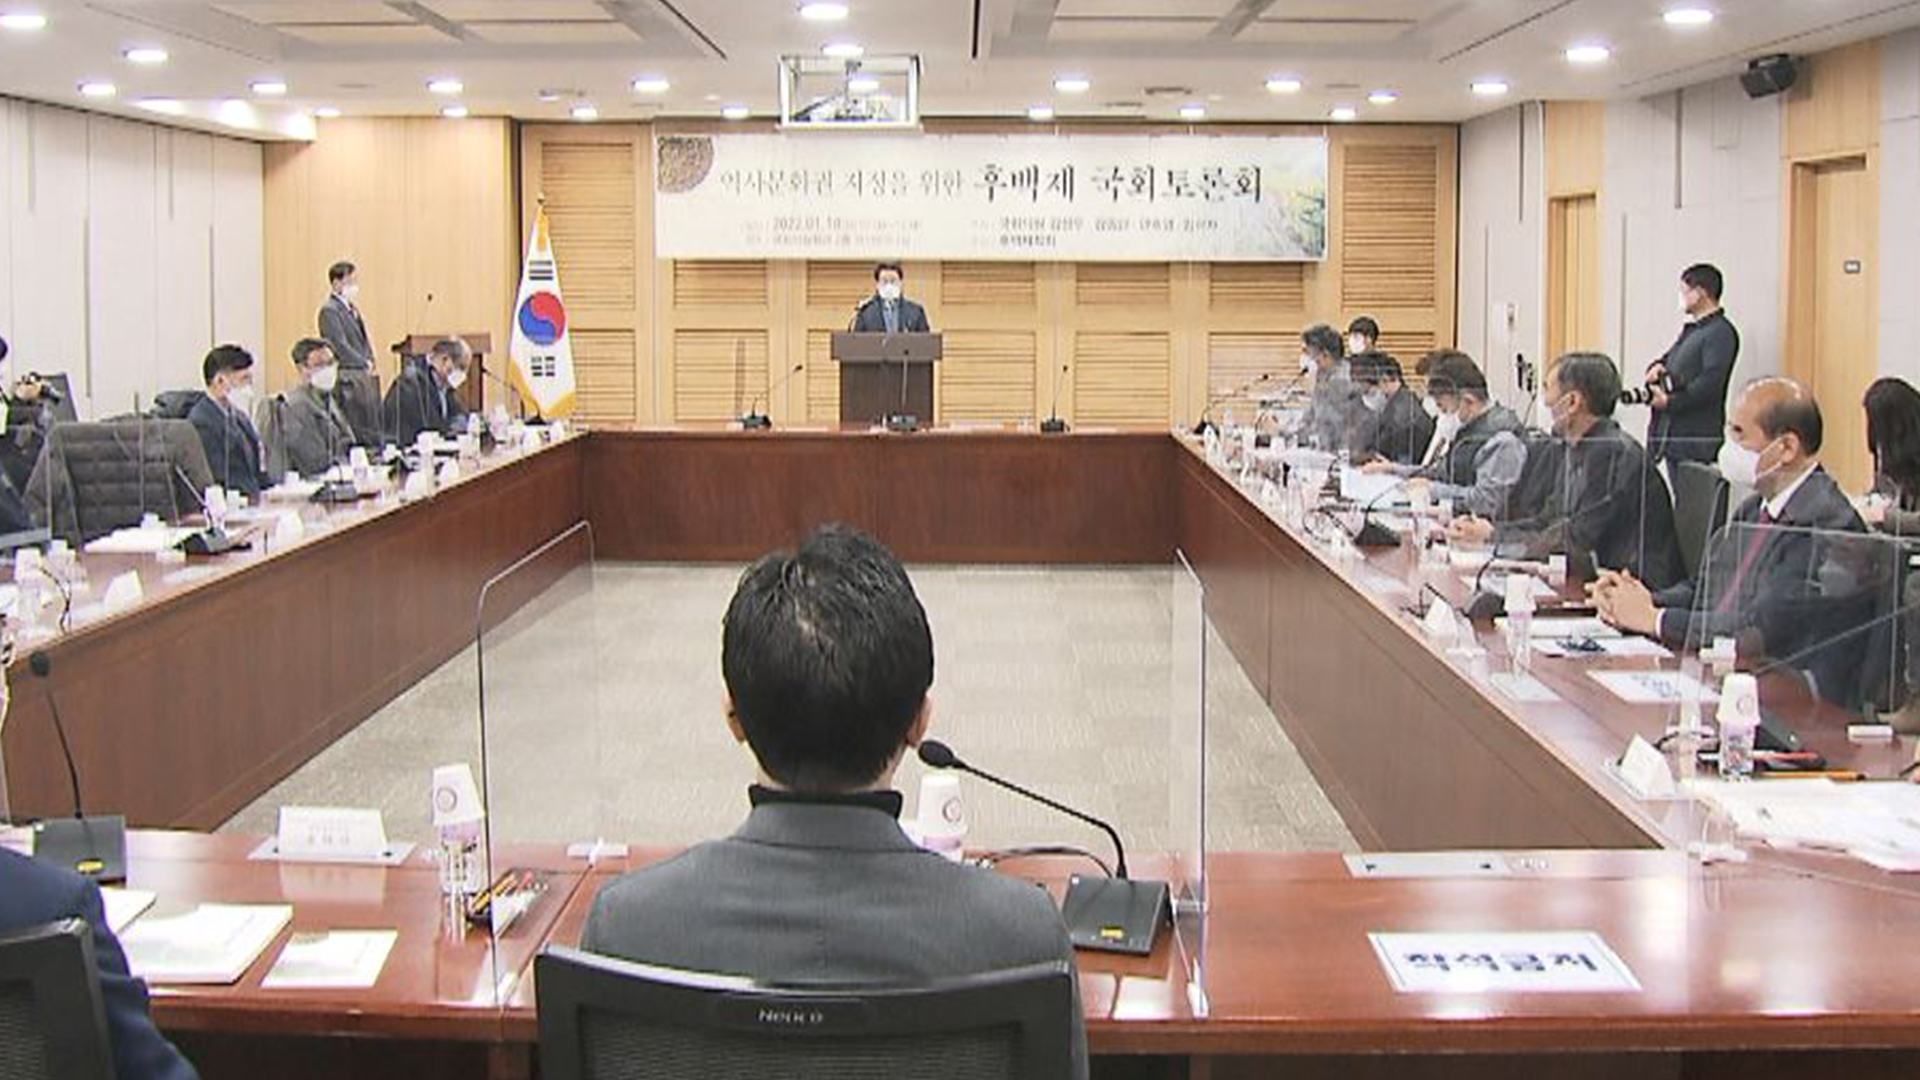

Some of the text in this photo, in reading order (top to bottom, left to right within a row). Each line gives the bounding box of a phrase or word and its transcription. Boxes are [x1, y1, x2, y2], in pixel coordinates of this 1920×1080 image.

[848, 169, 908, 197] 지정을
[920, 168, 962, 197] 위한
[974, 163, 1076, 203] 후백제
[1402, 952, 1601, 973] 착석금지
